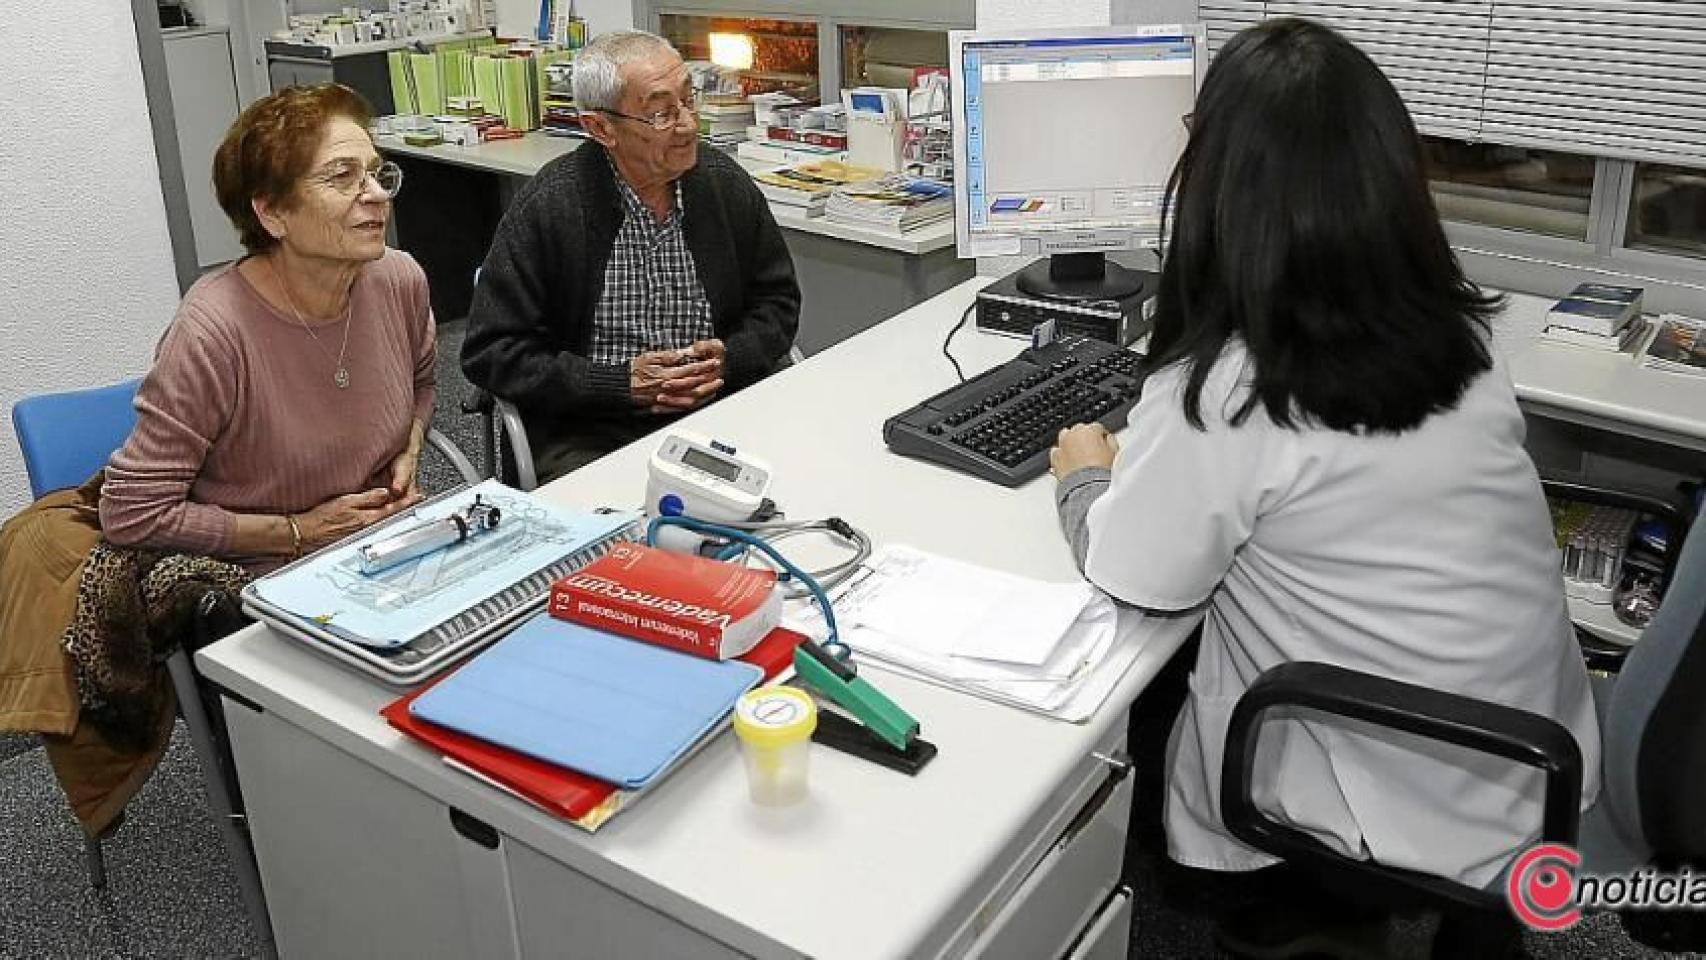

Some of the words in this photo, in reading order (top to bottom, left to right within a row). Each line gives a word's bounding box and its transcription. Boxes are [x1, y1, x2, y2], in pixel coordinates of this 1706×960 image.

[566, 573, 732, 631] Vademecum
[578, 601, 638, 629] Internacional
[639, 618, 700, 646] Vademecum
